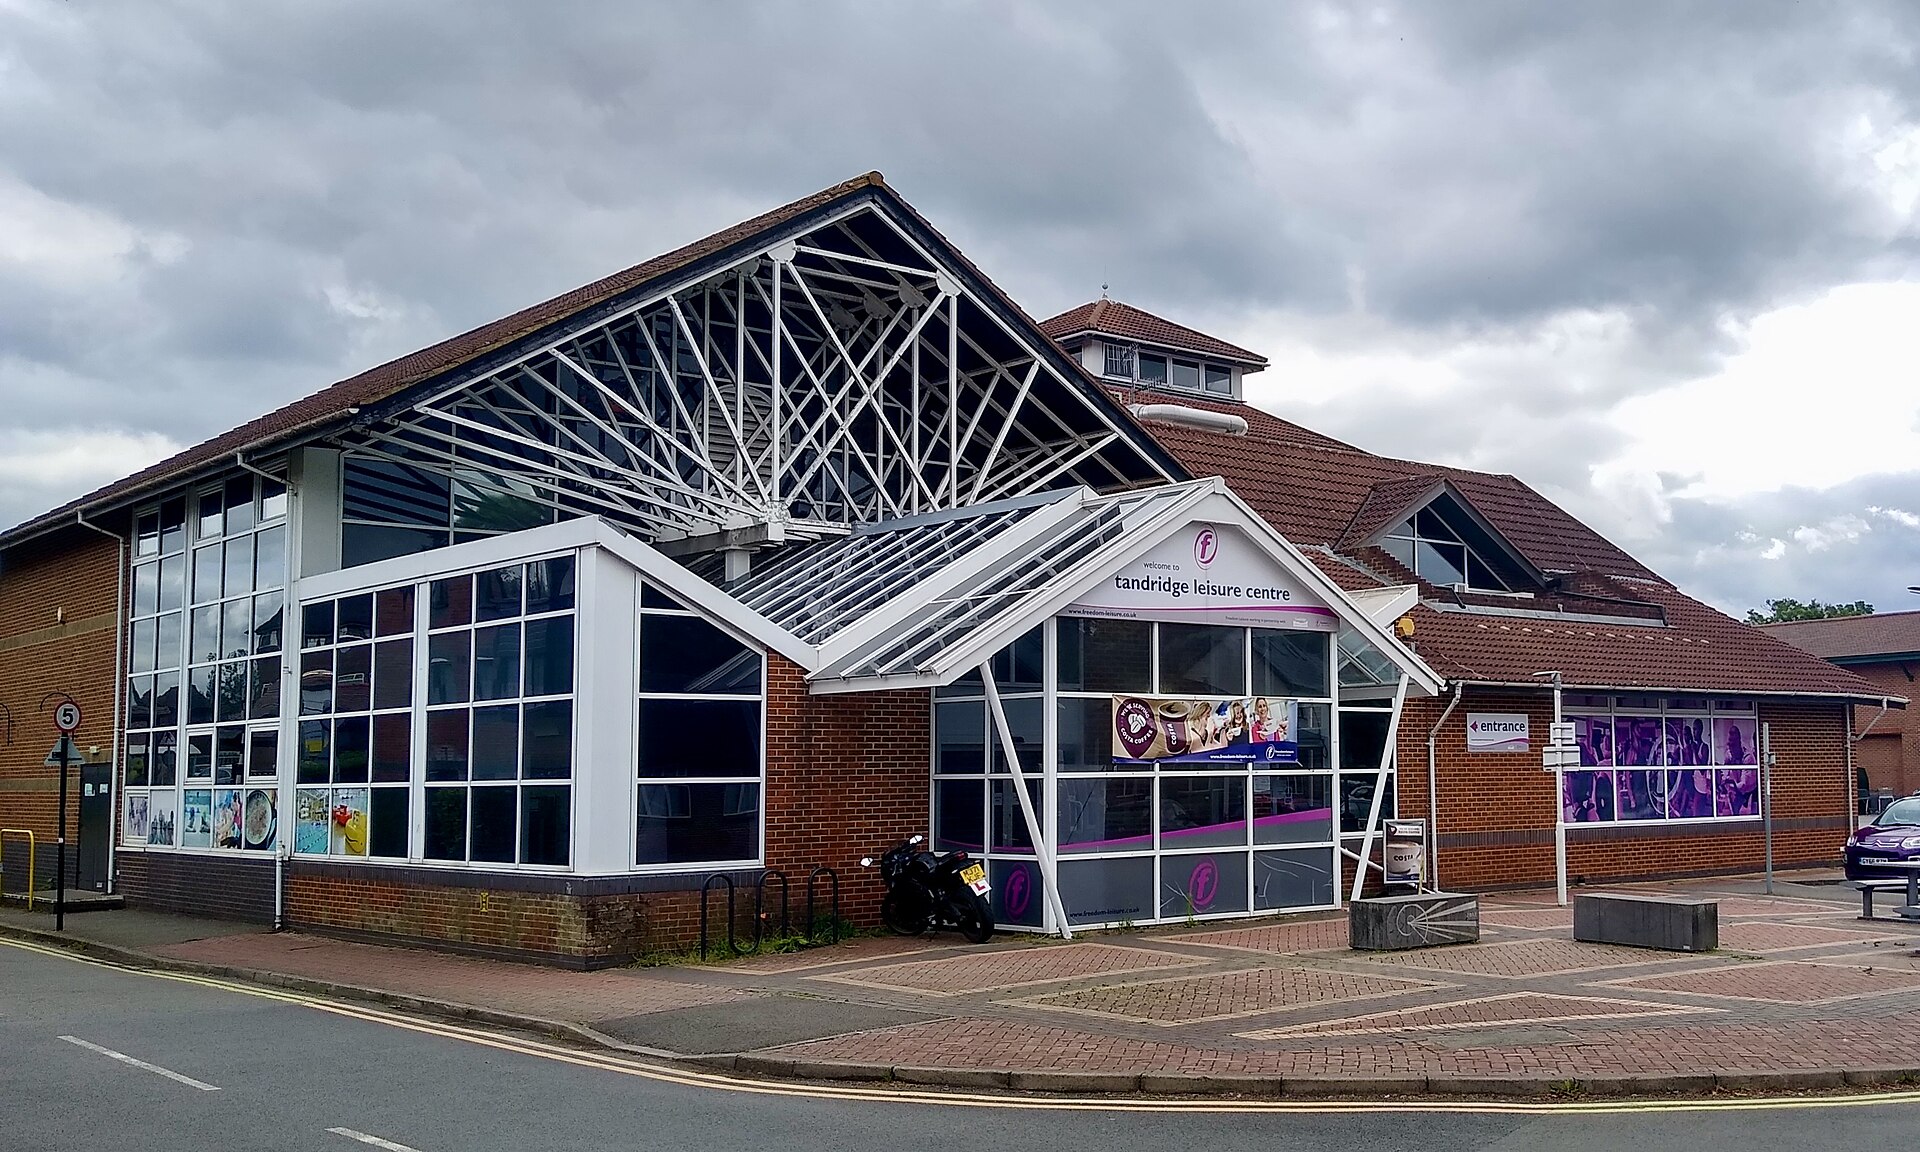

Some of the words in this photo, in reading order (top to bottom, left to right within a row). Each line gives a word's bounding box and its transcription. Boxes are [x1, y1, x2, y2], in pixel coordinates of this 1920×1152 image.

[1143, 561, 1171, 570] welcome
[1172, 563, 1180, 571] to
[1114, 574, 1189, 597] tandridge
[1193, 579, 1242, 597] leisure
[1245, 585, 1291, 601] centre
[1068, 608, 1137, 618] www.freedom-leisure.co.uk
[62, 707, 74, 725] 5
[1480, 720, 1526, 732] entrance
[1120, 727, 1134, 744] COSTA
[1134, 729, 1154, 745] COFFEE
[975, 881, 986, 891] L
